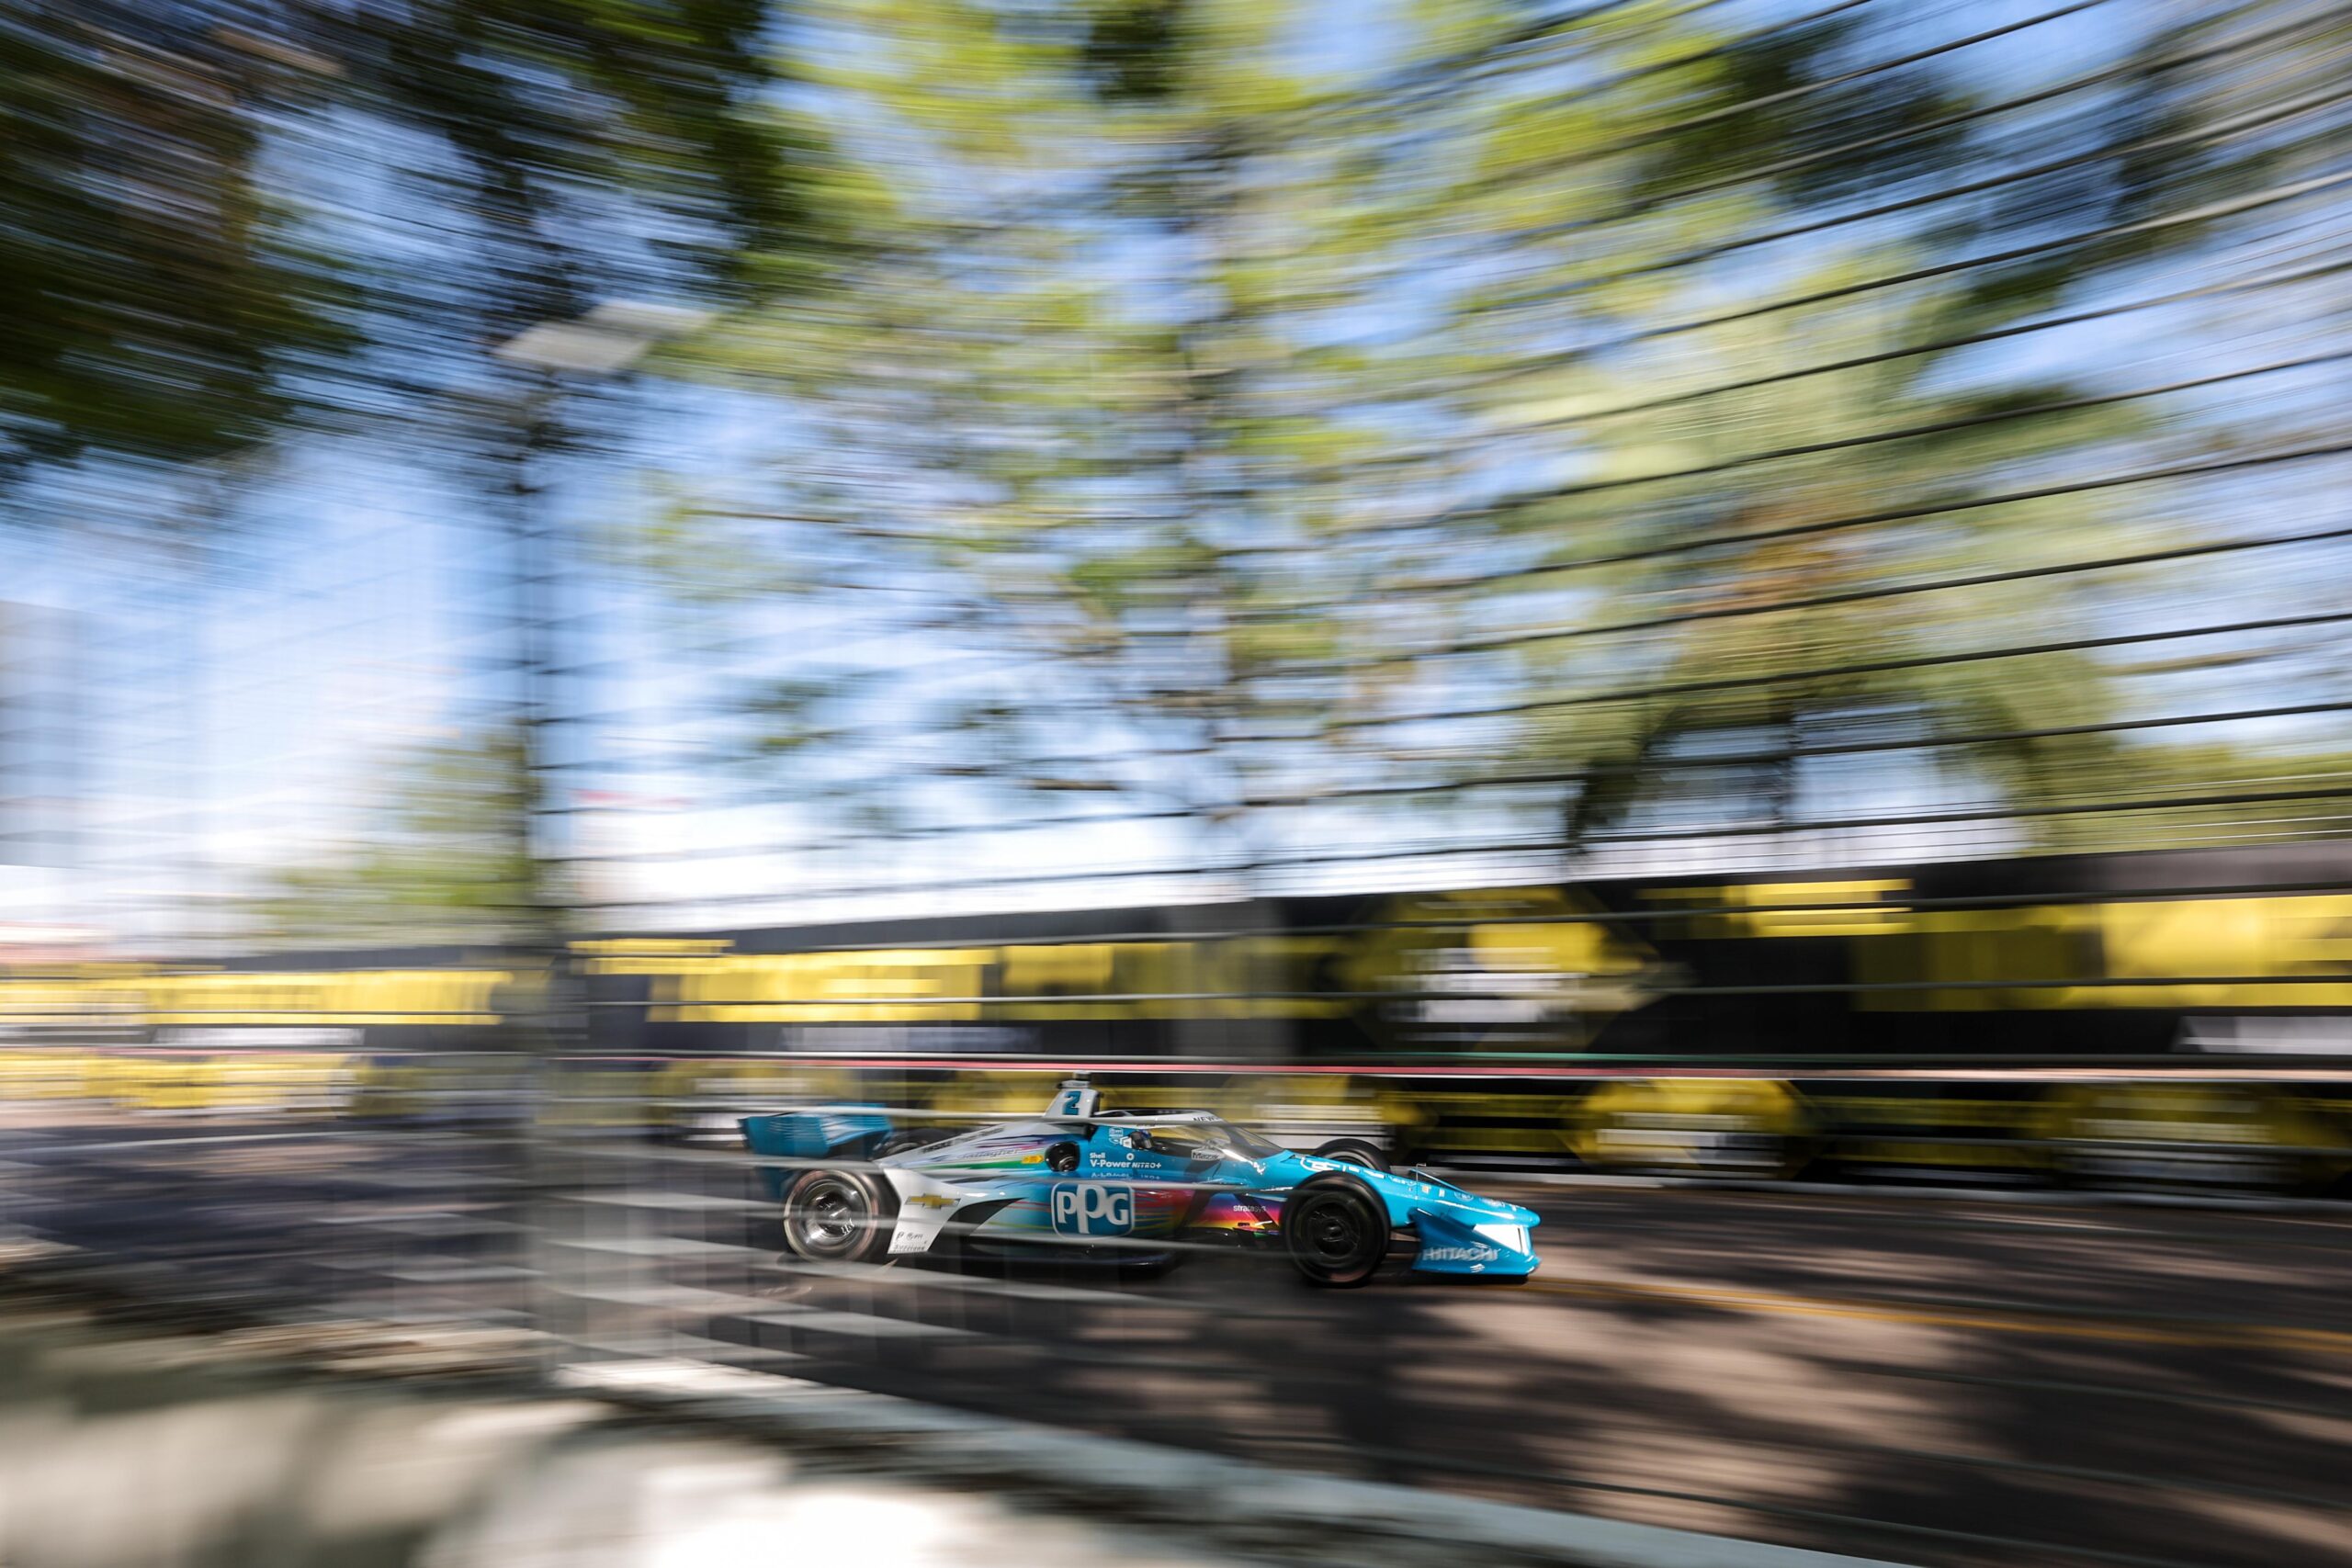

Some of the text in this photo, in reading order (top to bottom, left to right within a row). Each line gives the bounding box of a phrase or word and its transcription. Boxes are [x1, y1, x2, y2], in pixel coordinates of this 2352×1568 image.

[1062, 1090, 1081, 1115] 2
[1090, 1159, 1131, 1168] V-Power
[1057, 1184, 1129, 1234] PPG
[1423, 1247, 1499, 1262] HITACHI
